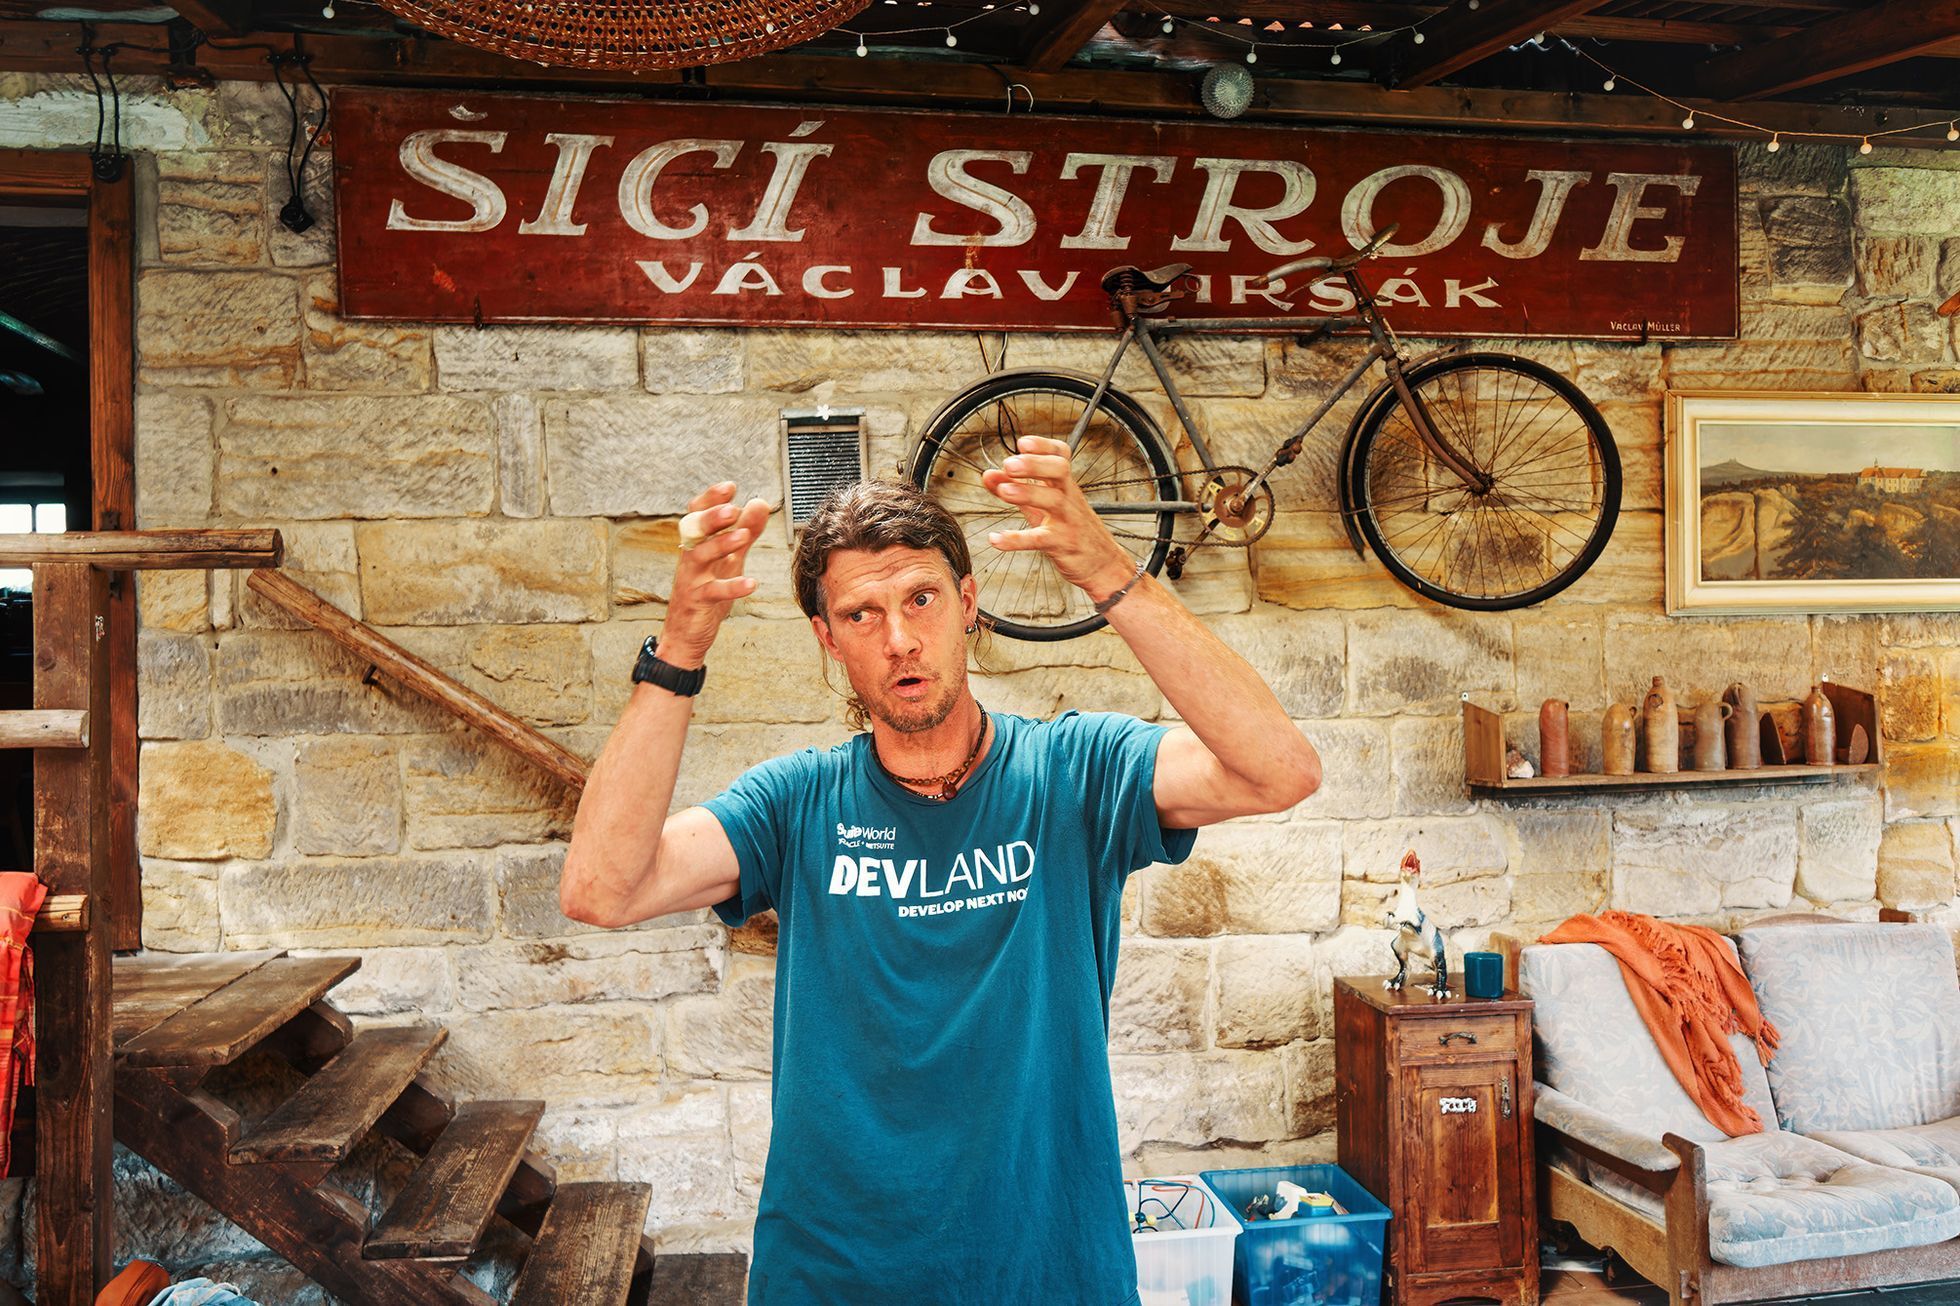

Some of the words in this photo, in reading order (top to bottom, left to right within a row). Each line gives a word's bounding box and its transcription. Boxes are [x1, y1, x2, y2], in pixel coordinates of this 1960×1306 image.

[386, 104, 834, 242] ŠICÍ
[910, 149, 1702, 263] STROJE
[635, 252, 1080, 300] VÁCLAV
[829, 841, 1036, 899] DEVLAND
[899, 901, 964, 918] DEVELOP
[967, 892, 1005, 910] NEXT
[1007, 887, 1029, 903] NO
